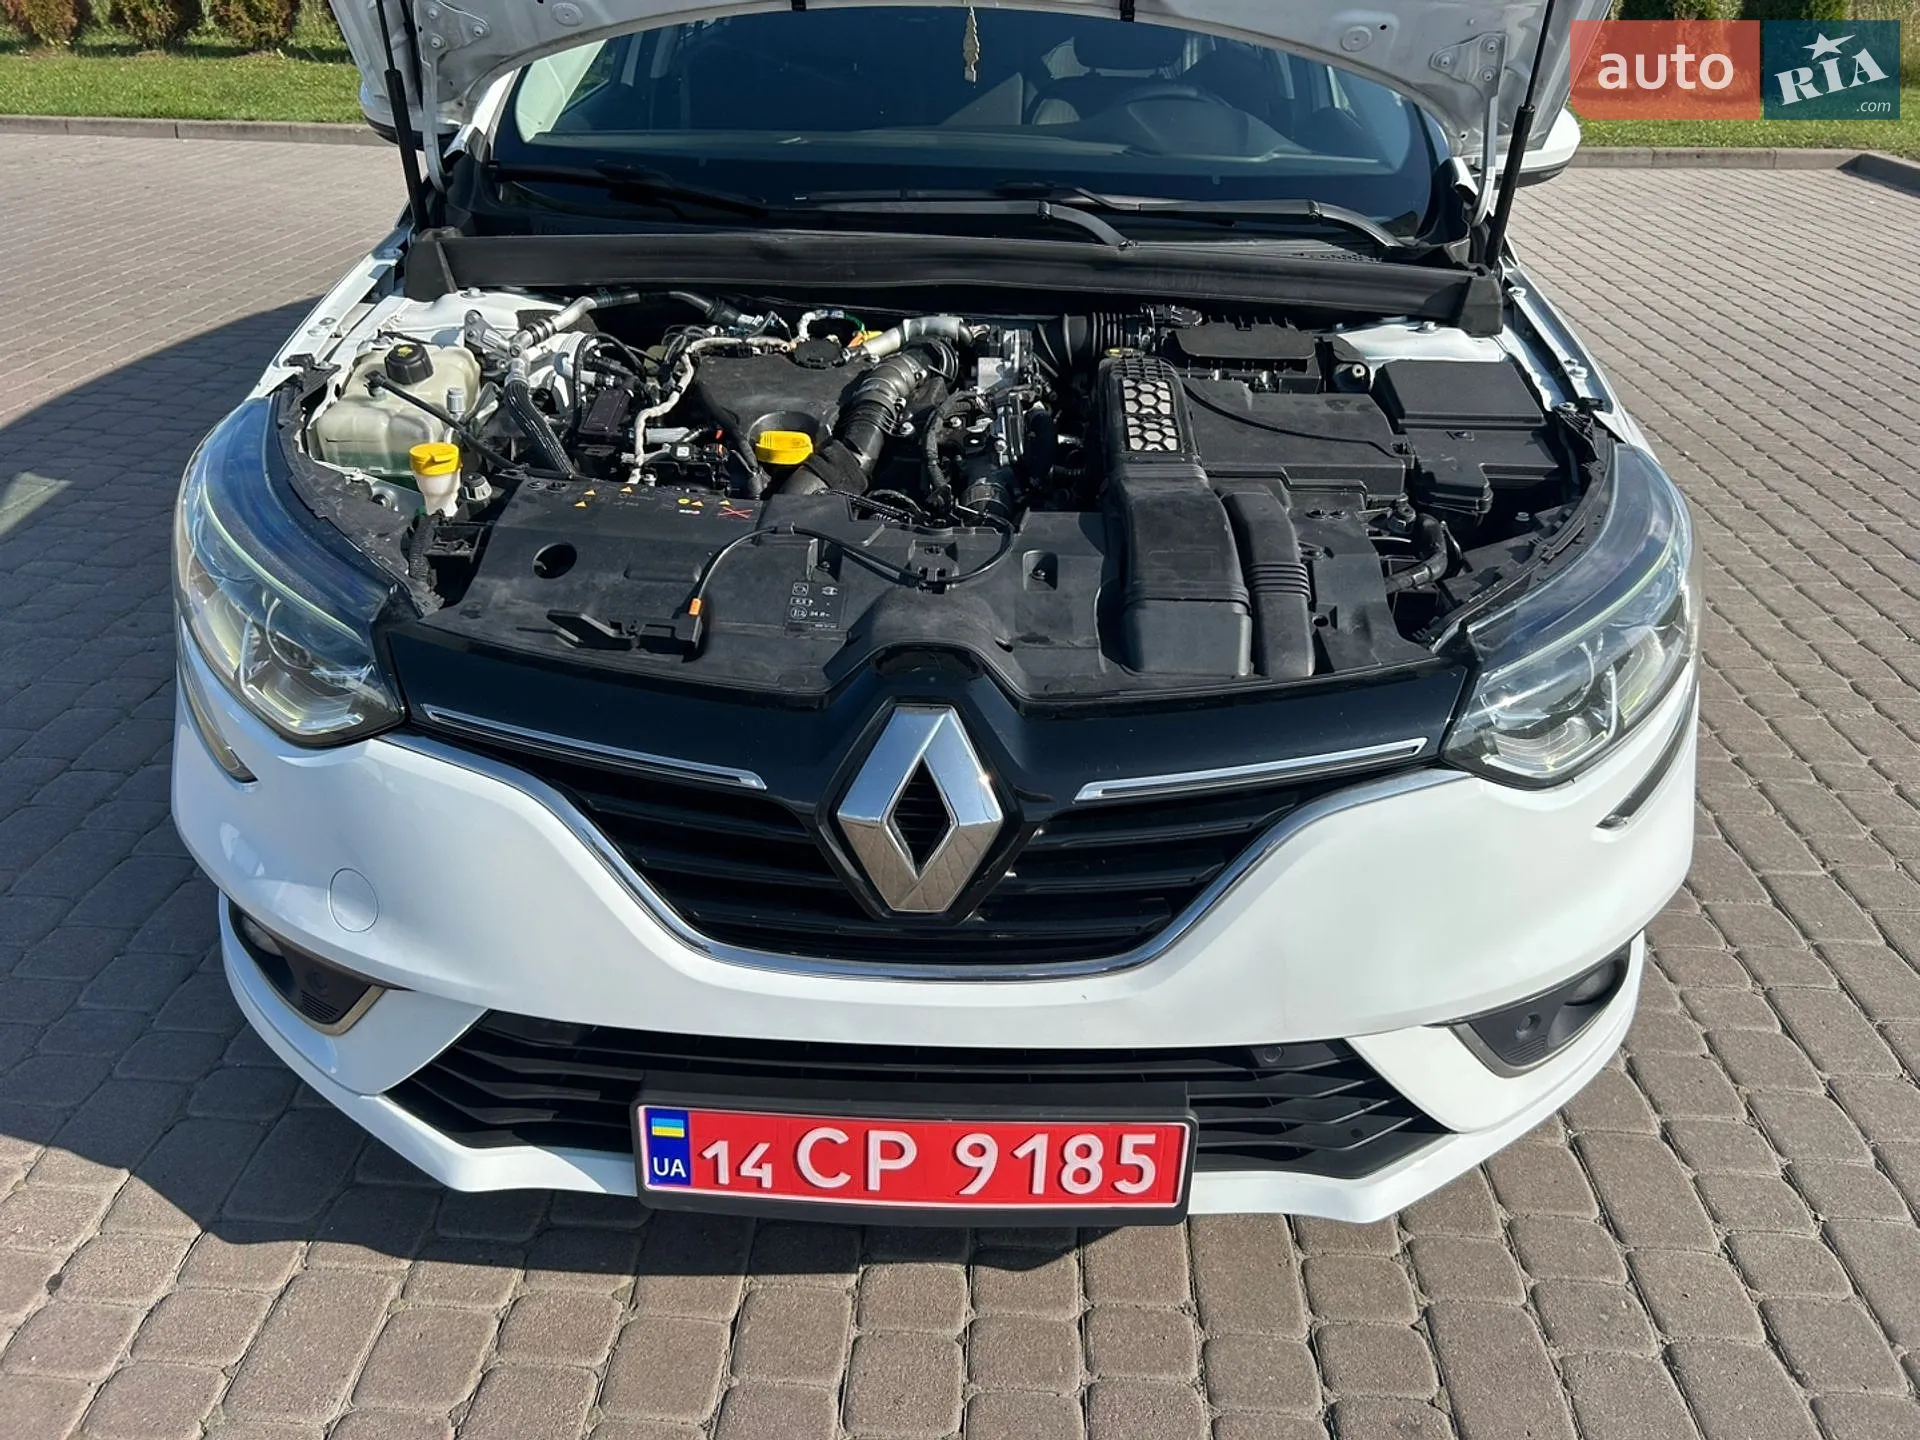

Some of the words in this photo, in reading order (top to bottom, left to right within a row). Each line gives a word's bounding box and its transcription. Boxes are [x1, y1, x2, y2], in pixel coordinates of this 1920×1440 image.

[653, 1157, 686, 1177] UA
[701, 1140, 773, 1189] 14
[796, 1126, 918, 1191] CP
[954, 1132, 1157, 1195] 9185
